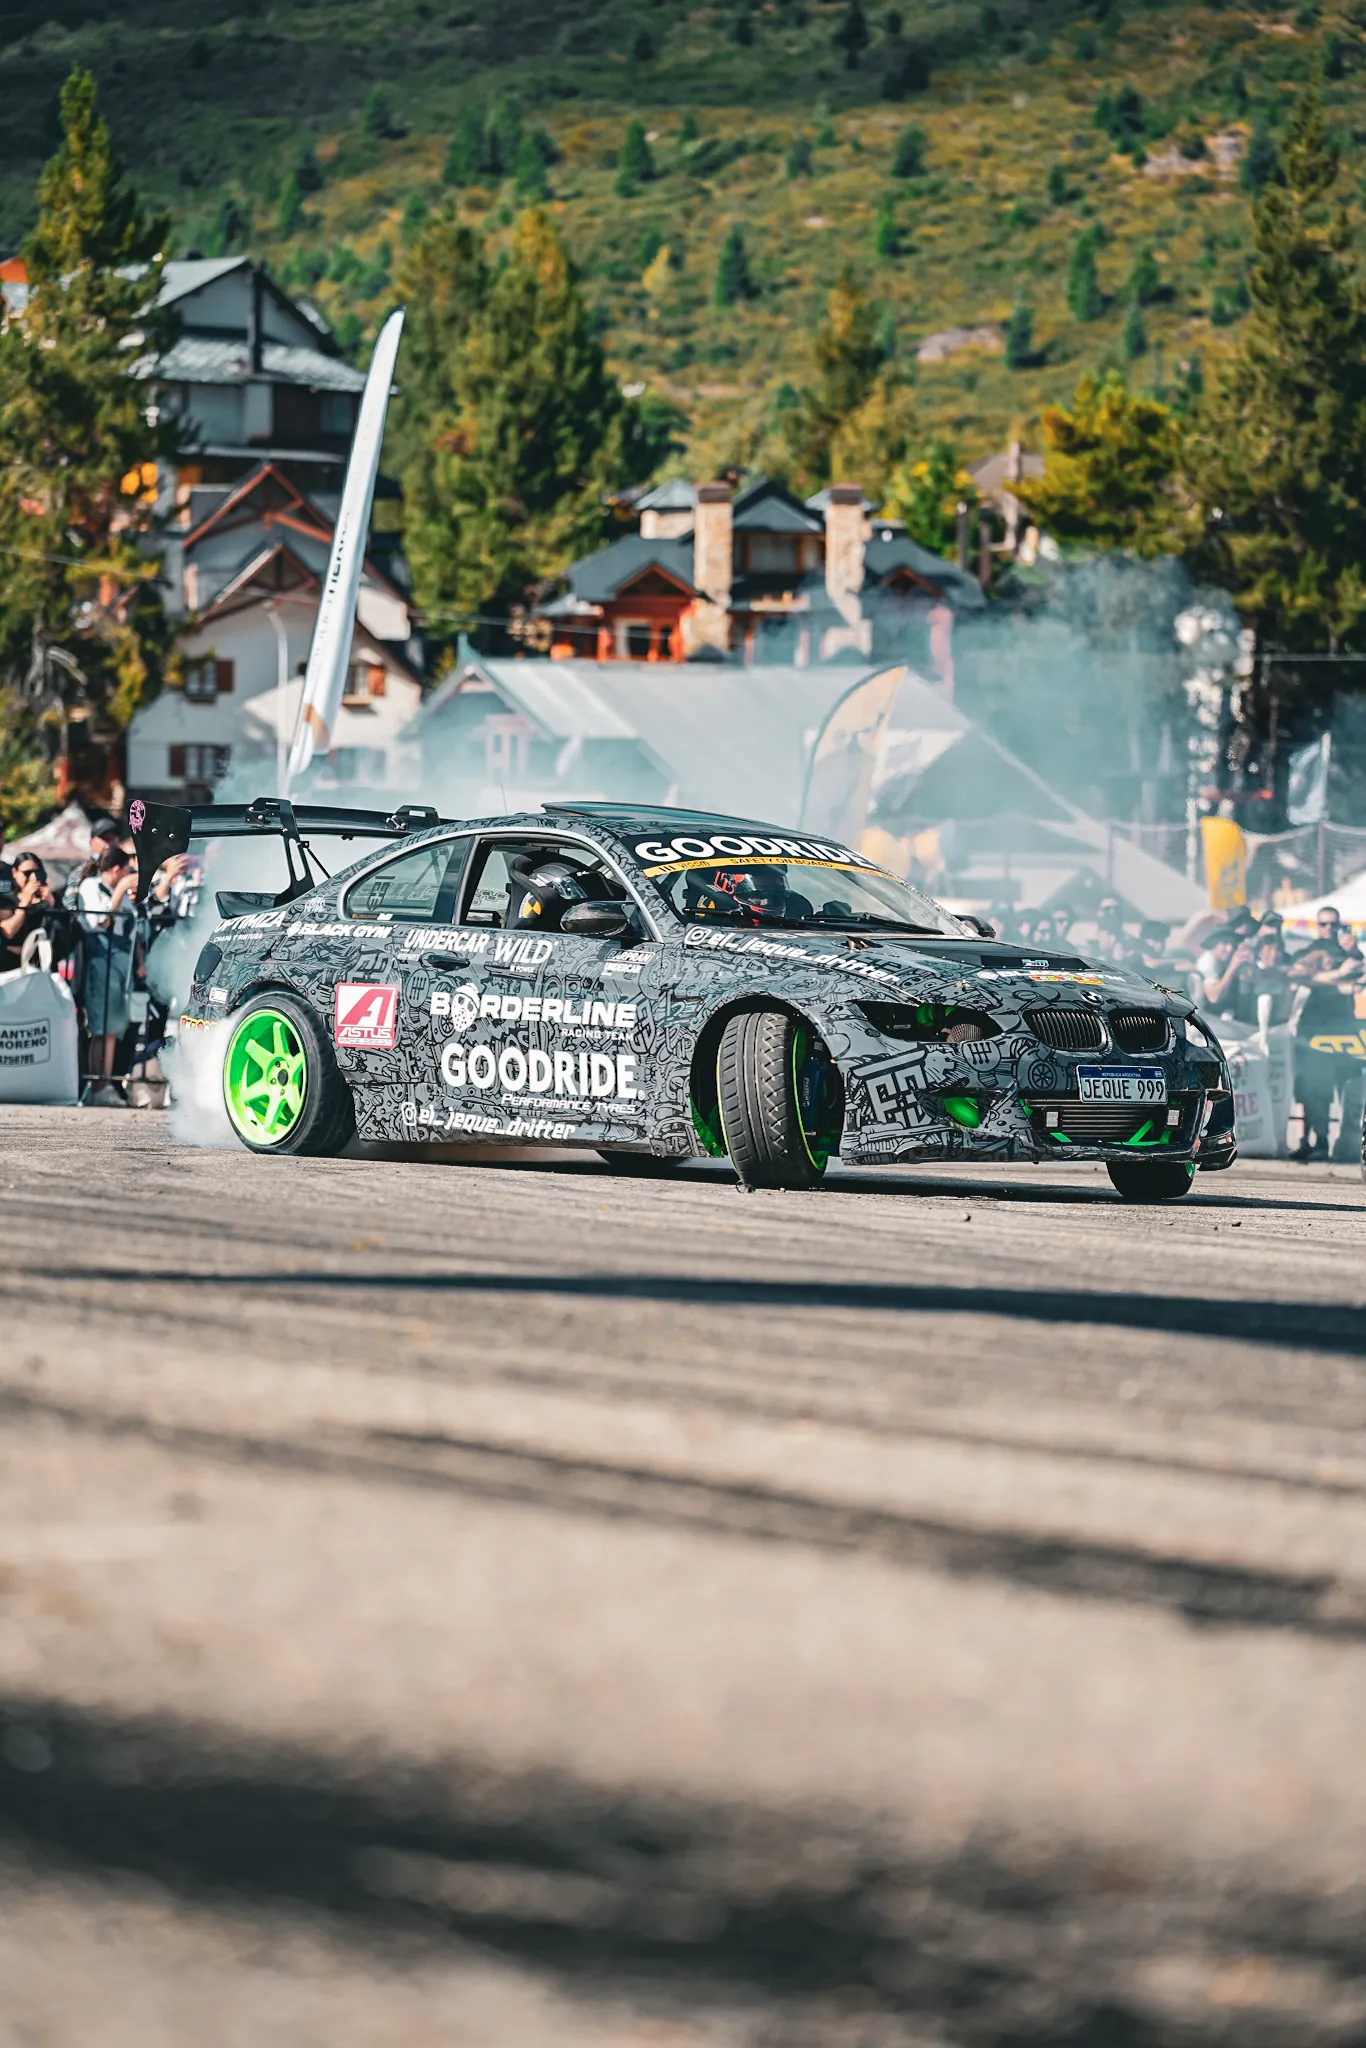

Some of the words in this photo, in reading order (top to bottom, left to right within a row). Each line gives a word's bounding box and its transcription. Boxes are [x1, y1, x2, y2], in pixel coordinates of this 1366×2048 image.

[634, 836, 878, 870] GOODRIDE
[213, 911, 286, 933] OPTIMIZA
[298, 924, 352, 937] BLACK
[353, 926, 393, 939] GYM
[403, 929, 490, 953] UNDERCAR
[493, 937, 554, 964] WILD
[430, 983, 637, 1032] BORDERLINE
[0, 1025, 48, 1039] ANTERA
[338, 1027, 392, 1039] ASTUS
[561, 1028, 601, 1040] RACING
[605, 1031, 634, 1041] TEAM
[441, 1043, 638, 1100] GOODRIDE
[1083, 1079, 1132, 1099] JEQUE
[1137, 1080, 1164, 1100] 999
[501, 1094, 592, 1111] PERFORMANCE
[594, 1101, 637, 1114] TYRES
[1235, 1092, 1259, 1117] RE
[418, 1104, 577, 1140] el_jeque_drifter
